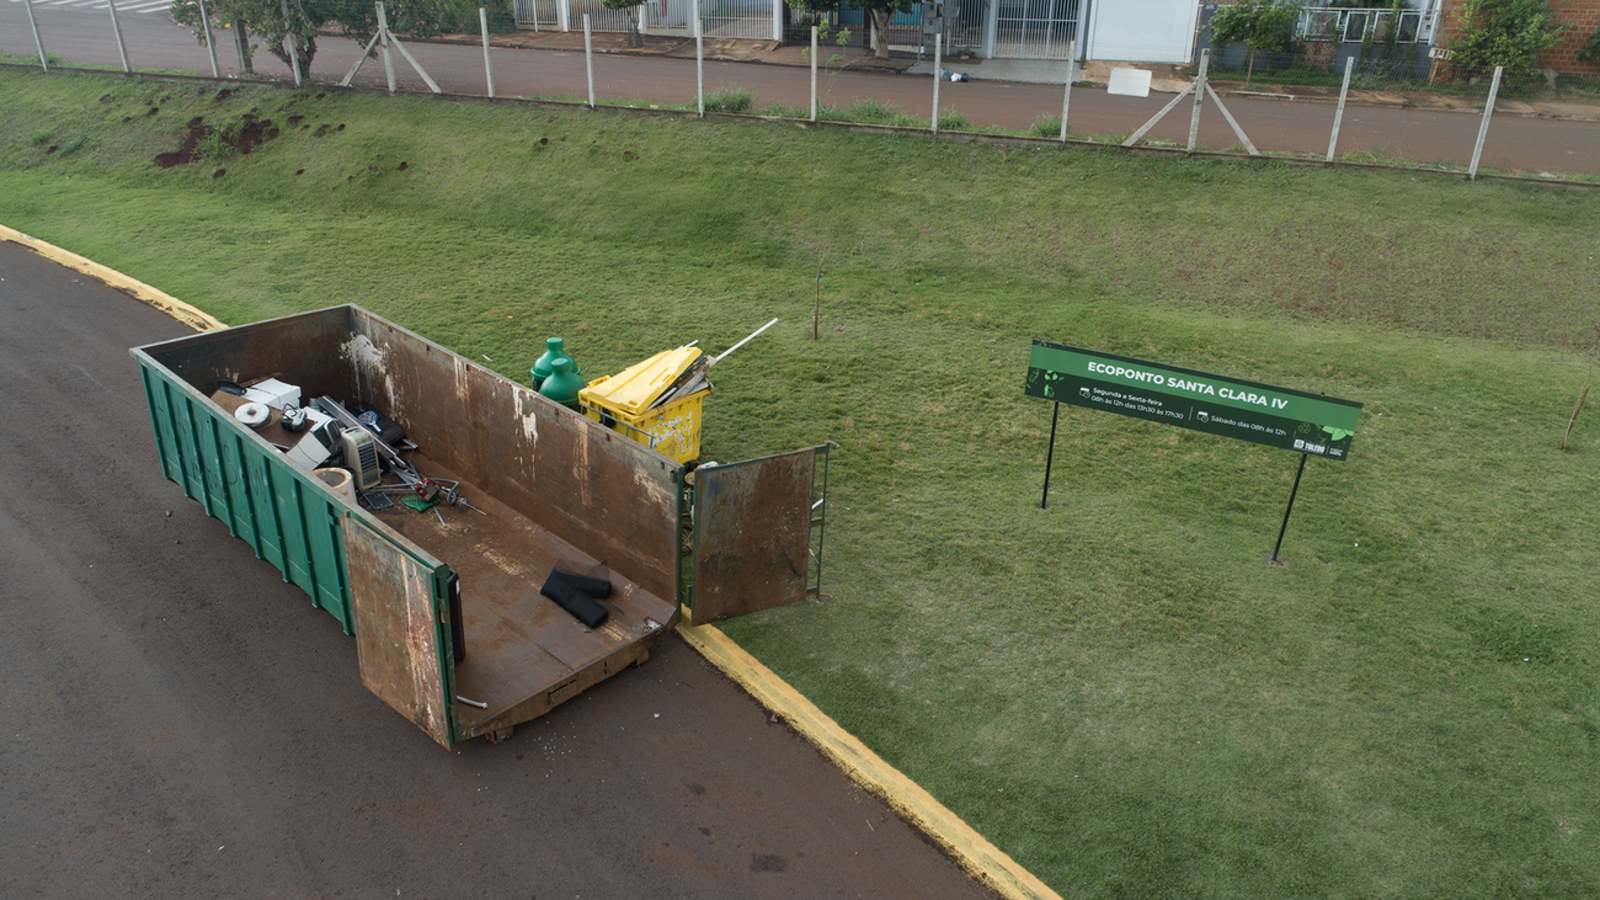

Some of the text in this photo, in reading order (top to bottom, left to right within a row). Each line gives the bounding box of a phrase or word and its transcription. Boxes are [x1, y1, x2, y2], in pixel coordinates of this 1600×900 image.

[1087, 361, 1289, 410] ECOPONTO SANTA CLARA IV
[1093, 387, 1122, 399] Segunda
[1128, 394, 1163, 407] Sexta-feira
[1113, 399, 1124, 407] 12h
[1125, 401, 1136, 410] das
[1137, 404, 1156, 414] 13h30
[1211, 415, 1236, 426] Sábado
[1237, 420, 1250, 429] das
[1275, 428, 1287, 437] 12h
